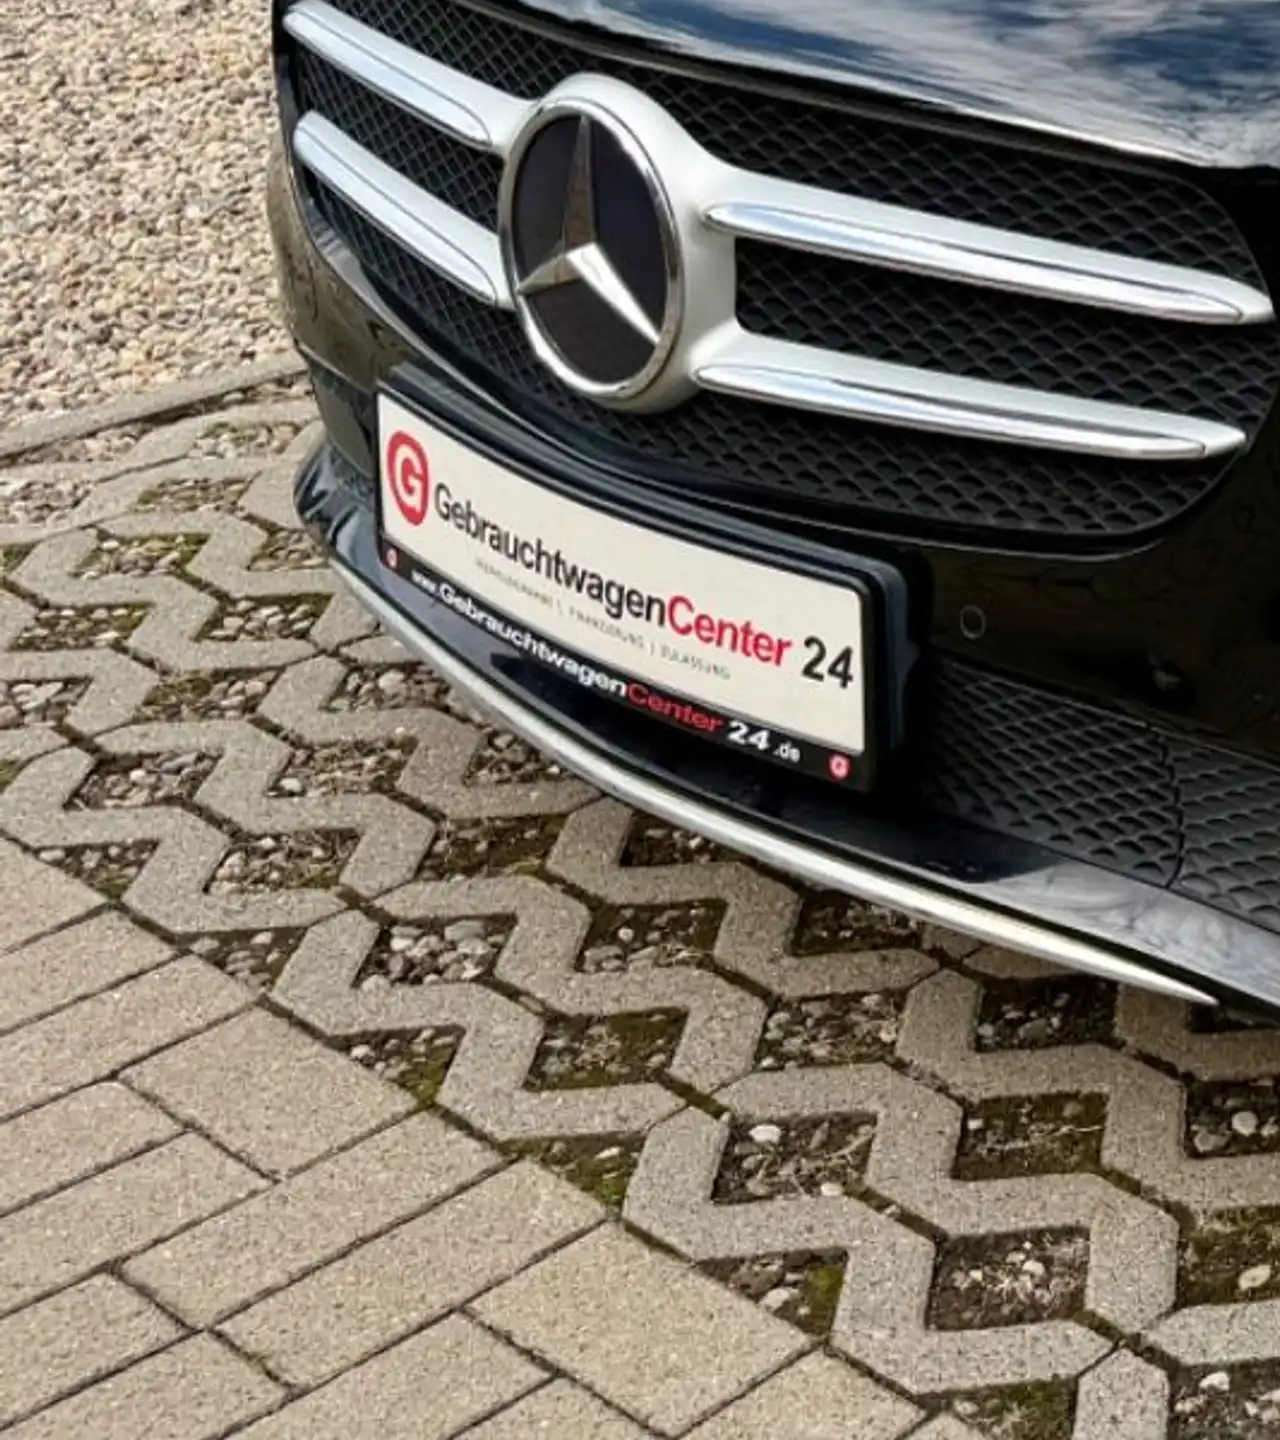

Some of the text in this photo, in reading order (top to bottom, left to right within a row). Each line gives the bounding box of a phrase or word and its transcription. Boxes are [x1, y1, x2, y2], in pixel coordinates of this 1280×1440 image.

[434, 482, 854, 689] GebrauchtwagenCenter 24
[727, 719, 770, 751] 24
